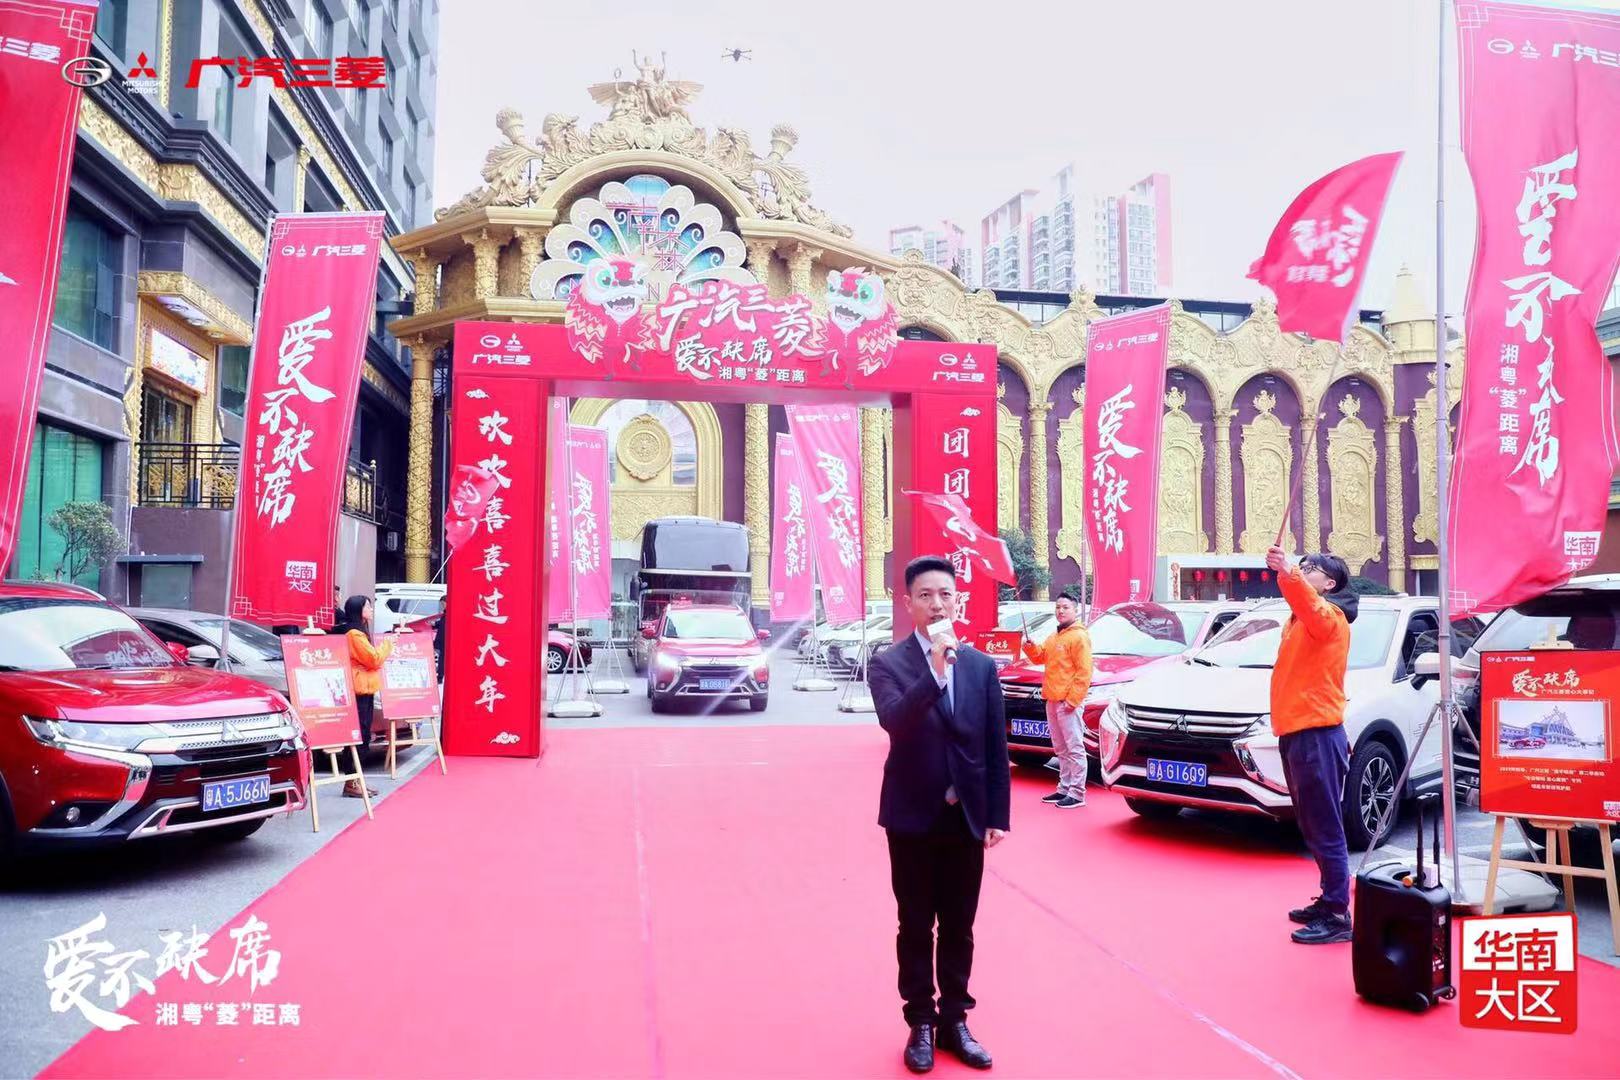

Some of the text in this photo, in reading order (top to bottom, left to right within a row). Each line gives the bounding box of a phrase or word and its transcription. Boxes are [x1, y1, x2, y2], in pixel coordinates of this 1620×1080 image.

[0, 36, 60, 64] 三菱
[1552, 43, 1620, 67] 广汽三
[311, 244, 367, 257] 广汽三菱
[658, 283, 823, 358] 广汽三菱
[471, 353, 532, 366] 广汽三菱
[675, 332, 773, 381] 爱不缺席
[931, 370, 985, 383] 广汽三菱
[259, 306, 337, 529] 爱不缺席
[1092, 384, 1144, 554] 爱不缺席
[1565, 536, 1598, 556] 华南
[287, 563, 313, 580] 华南
[472, 410, 513, 713] 欢欢喜喜过大年
[288, 580, 313, 593] 大区
[1512, 668, 1580, 698] 爱不缺席
